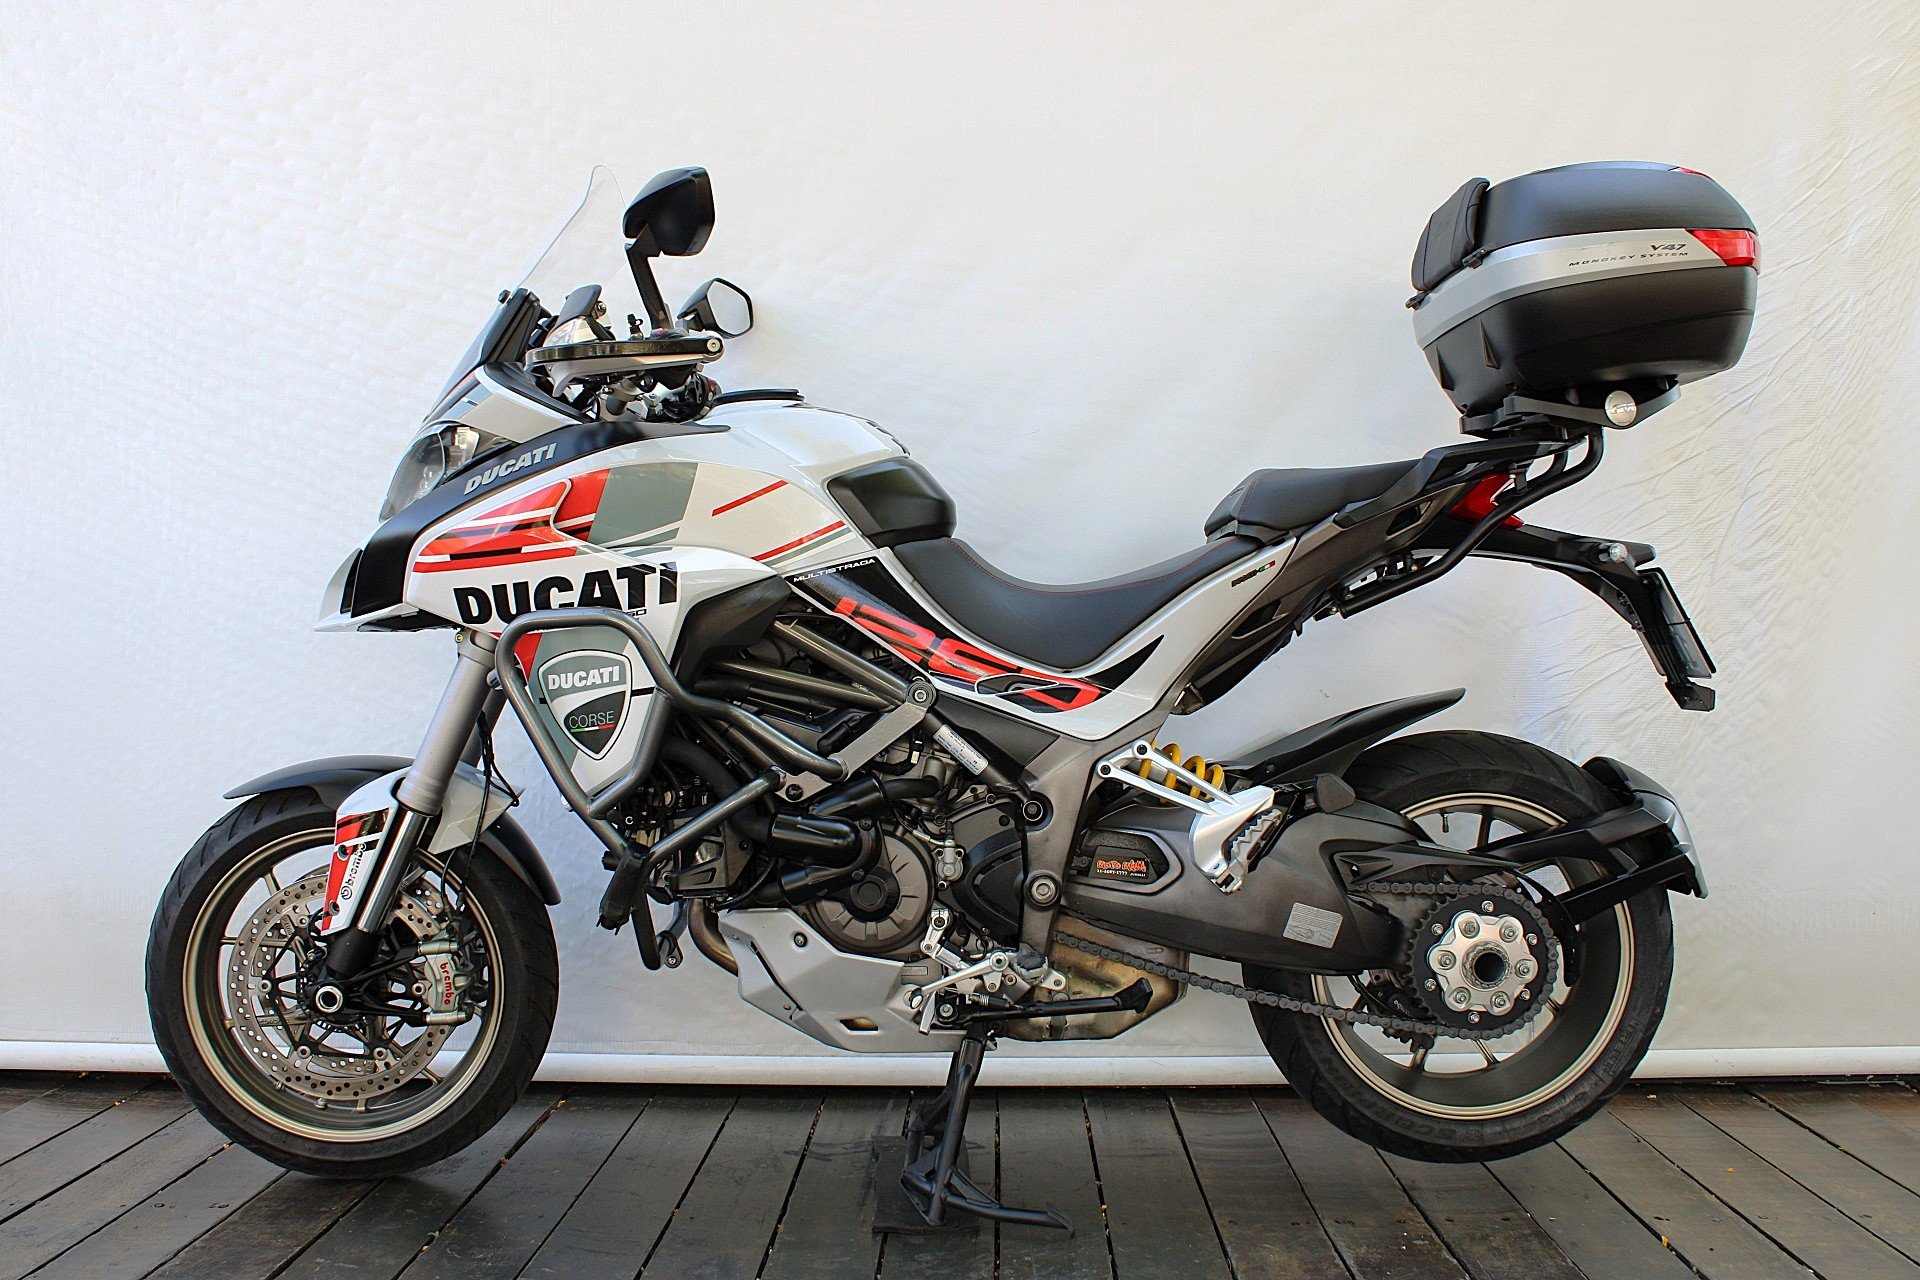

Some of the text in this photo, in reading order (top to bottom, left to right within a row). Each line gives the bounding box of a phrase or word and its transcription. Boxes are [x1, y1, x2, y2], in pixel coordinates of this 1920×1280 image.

[1650, 243, 1687, 251] V47
[1568, 254, 1636, 267] MONOKEY
[463, 442, 557, 495] DUCATI
[793, 558, 876, 582] MULTISTRADA
[453, 561, 678, 625] DUCATI
[547, 665, 620, 690] DUCATI
[568, 710, 615, 728] CORSE
[345, 842, 367, 887] brembo
[439, 961, 455, 1006] brembo
